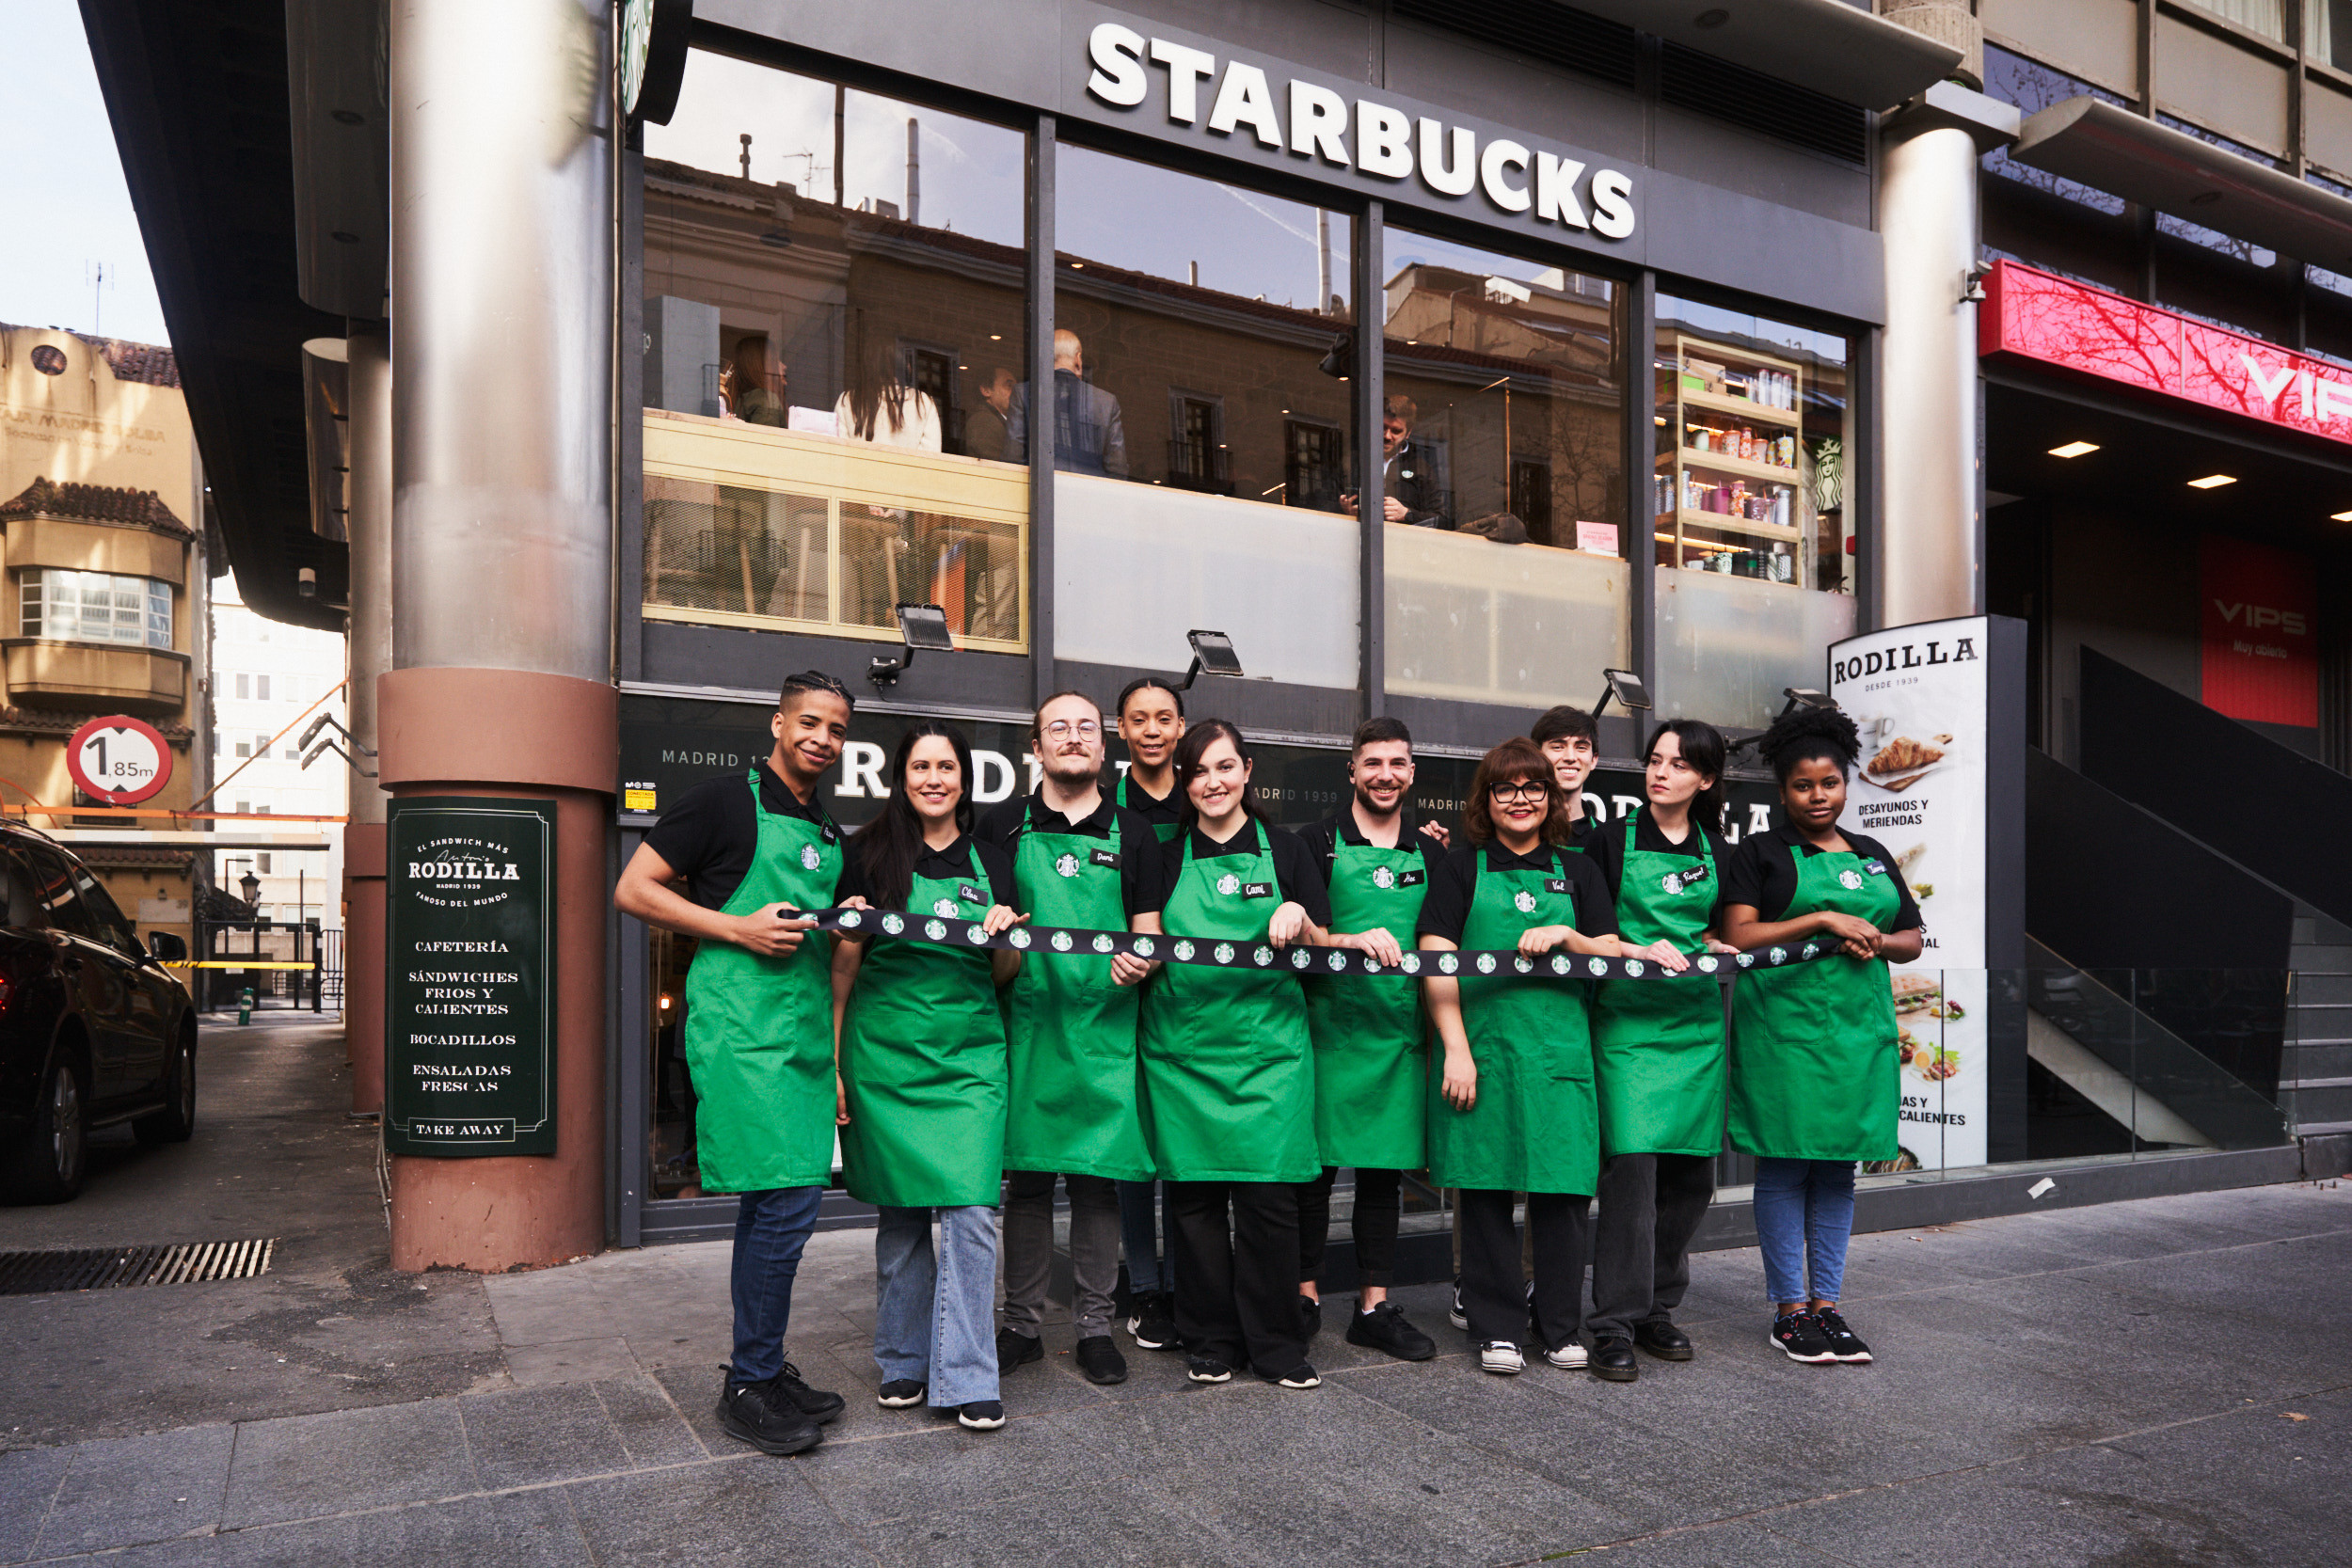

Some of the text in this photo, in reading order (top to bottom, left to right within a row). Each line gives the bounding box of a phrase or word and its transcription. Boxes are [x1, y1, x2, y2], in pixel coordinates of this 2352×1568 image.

[1088, 23, 1635, 239] STARBUCKS
[2213, 598, 2306, 636] VIPS
[2233, 640, 2287, 658] Muy abierto
[1835, 638, 1979, 685] RODILLA
[1865, 676, 1919, 691] DESDE 1939
[661, 749, 739, 767] MADRID
[1253, 786, 1338, 803] ADRID 1939
[1418, 798, 1467, 811] MADRID
[1859, 800, 1929, 816] DESAYUNOS Y
[1862, 815, 1922, 829] MERIENDAS
[417, 844, 427, 853] EL
[430, 837, 482, 847] SANDWICH
[408, 862, 520, 880] RODILLA
[1551, 879, 1565, 891] Val
[416, 891, 446, 906] FAMOSO
[473, 892, 508, 906] MUNDO
[415, 940, 509, 953] CAFETERÍA
[408, 970, 518, 983] SÁNDWICHES
[425, 988, 494, 999] FRIOS Y
[415, 1004, 509, 1015] CALIENTES
[410, 1034, 516, 1045] BOCADILLOS
[413, 1064, 512, 1076] ENSALADAS
[1919, 1097, 1928, 1108] Y
[1899, 1110, 1966, 1126] CALIENTES
[416, 1124, 504, 1135] TAKE AWAY
